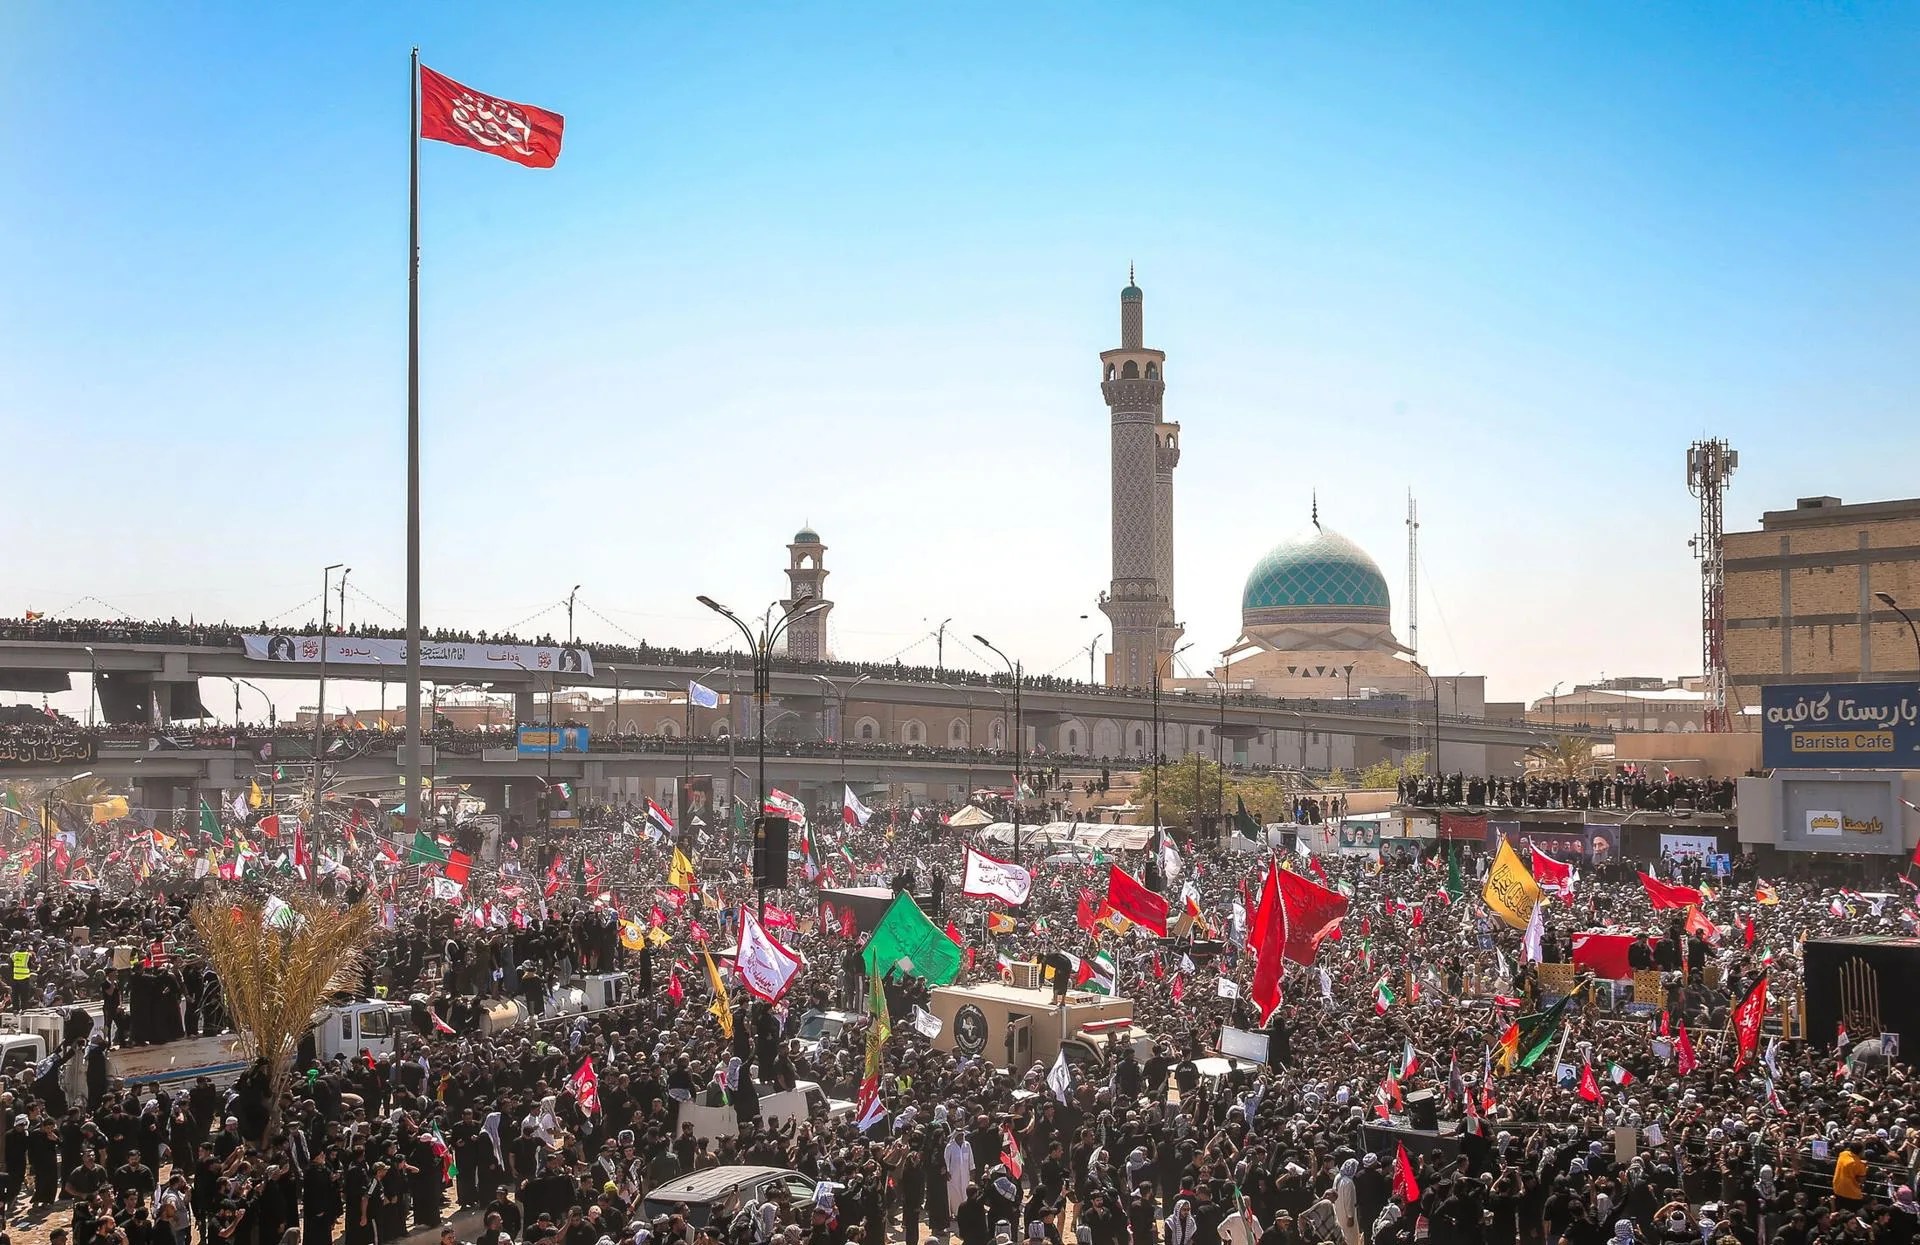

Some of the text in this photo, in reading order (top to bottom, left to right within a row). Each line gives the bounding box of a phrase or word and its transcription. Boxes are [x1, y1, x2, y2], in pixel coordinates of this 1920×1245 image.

[1838, 698, 1917, 729] باريستا
[1794, 734, 1892, 749] Barista Cafe
